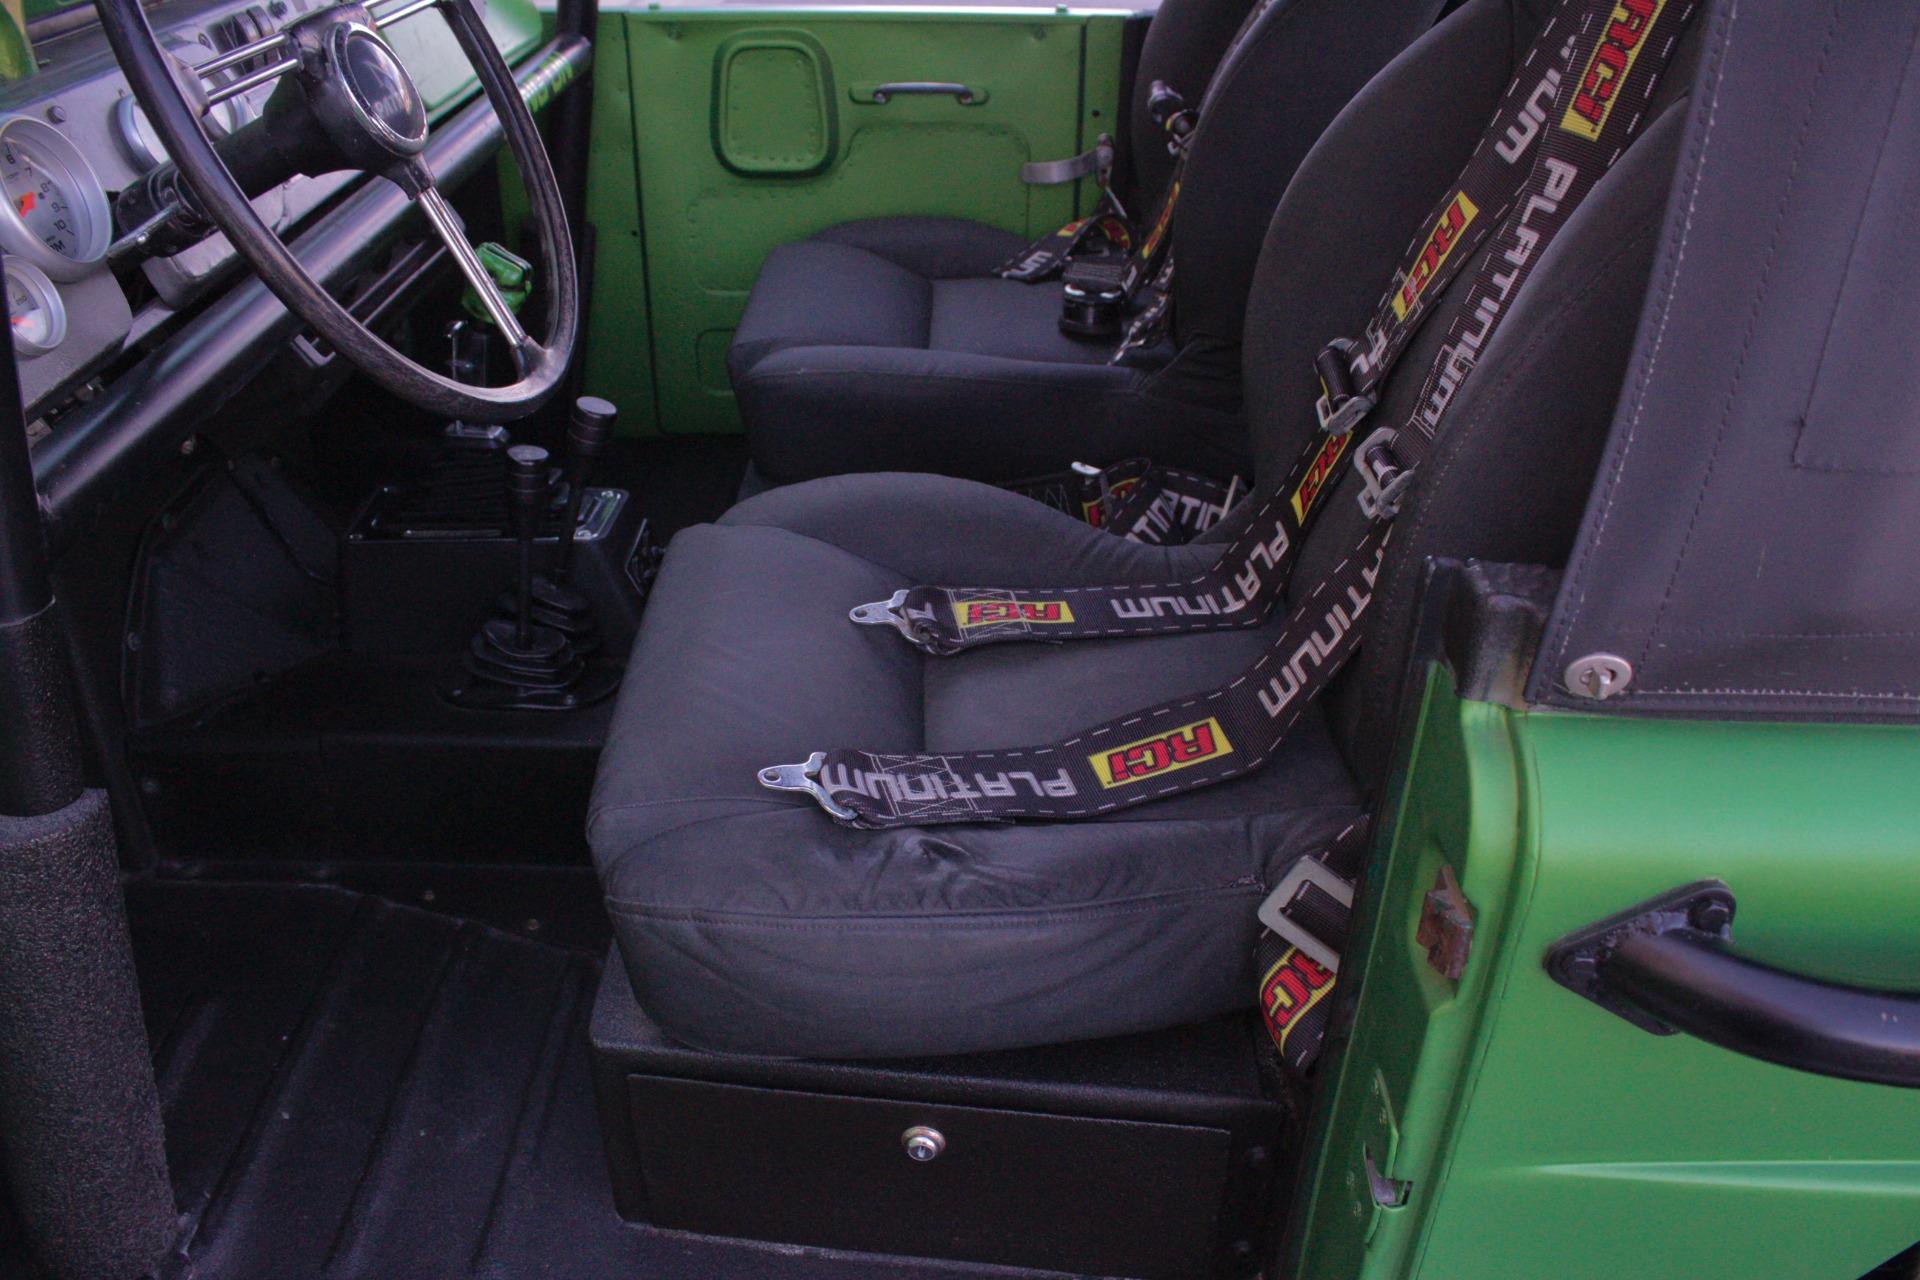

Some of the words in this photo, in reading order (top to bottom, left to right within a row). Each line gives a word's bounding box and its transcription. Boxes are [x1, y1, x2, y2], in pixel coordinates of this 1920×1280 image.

[53, 219, 67, 231] 10
[1424, 157, 1578, 427] PLATINUM
[1109, 520, 1290, 619] PLATINUM
[819, 763, 1078, 800] PLATINUM
